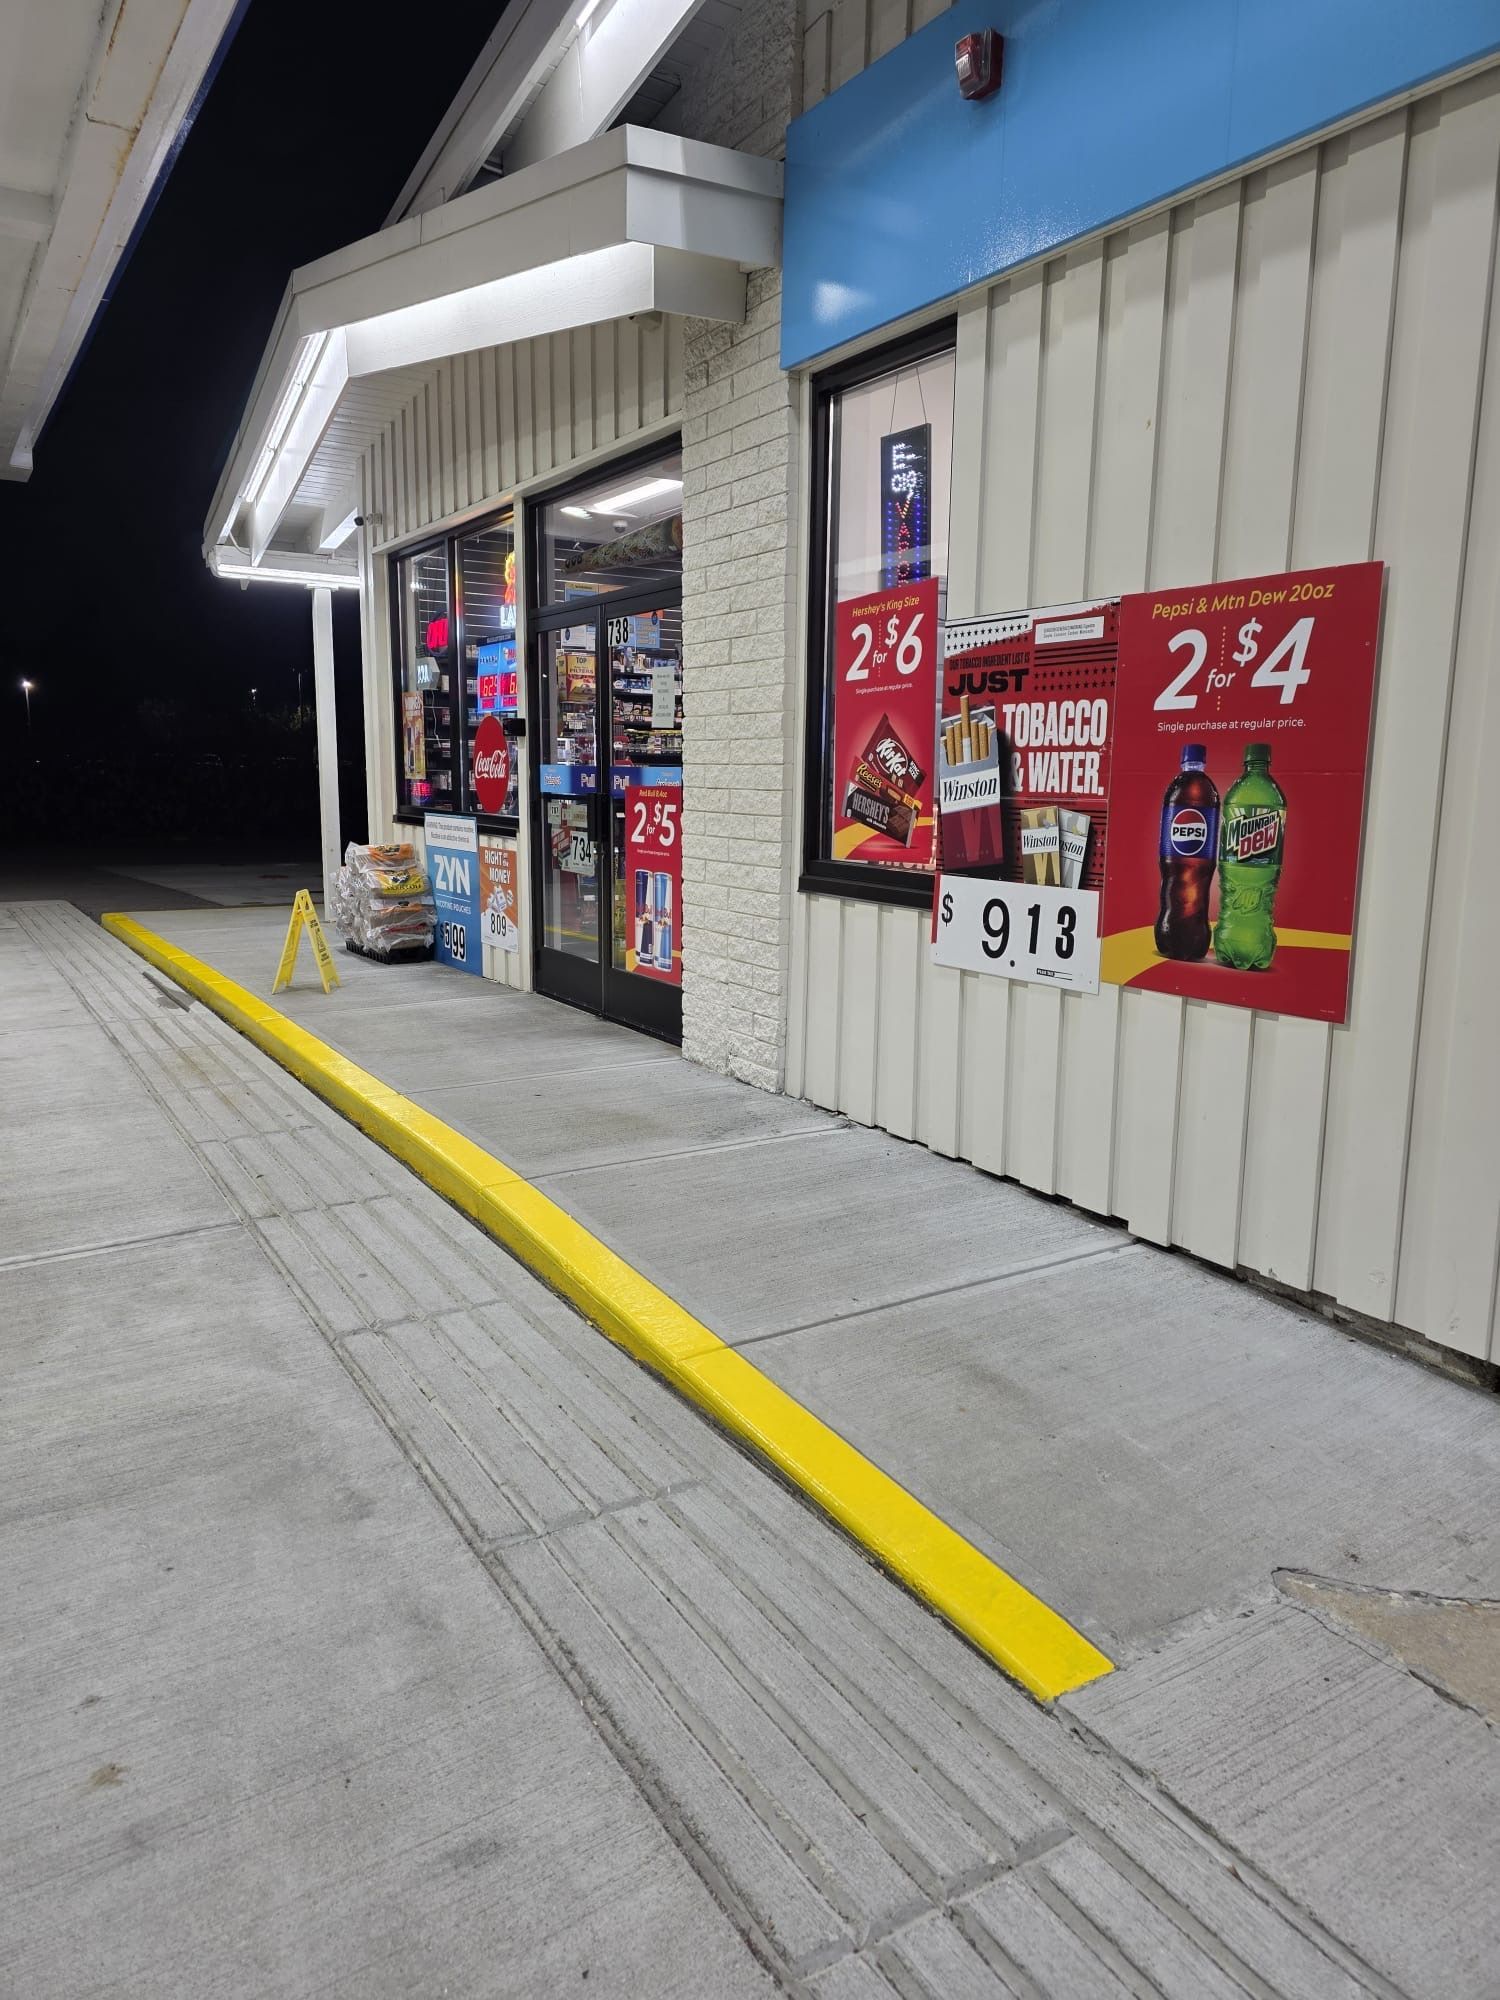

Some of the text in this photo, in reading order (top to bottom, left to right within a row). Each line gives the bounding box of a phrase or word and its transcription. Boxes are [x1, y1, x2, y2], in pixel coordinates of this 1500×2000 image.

[852, 596, 920, 618] Hershey's King Size
[1152, 583, 1335, 620] Pepsi & Mtn Dew 20oz
[608, 618, 628, 646] 738
[846, 623, 873, 682] 2
[872, 650, 888, 668] for
[960, 656, 981, 669] TOBACCO
[982, 653, 1011, 667] INGREDIENT
[1012, 652, 1024, 664] LIST
[1024, 652, 1030, 663] IS
[948, 668, 1029, 696] JUST
[1153, 628, 1208, 711] 2
[1206, 668, 1236, 692] for
[1002, 699, 1108, 747] TOBACCO
[1158, 717, 1306, 734] Single purchase at regular price.
[581, 774, 596, 788] Pull
[614, 776, 630, 790] Pull
[857, 763, 882, 788] Reese's
[1011, 751, 1104, 796] & WATER.
[943, 778, 997, 802] Winston
[852, 792, 890, 824] HERSHEY'S
[631, 802, 647, 843] 2
[646, 824, 655, 835] for
[1172, 827, 1206, 837] PEPSI
[572, 836, 591, 862] 734
[1023, 834, 1057, 848] Winston
[484, 850, 502, 865] RIGHT
[434, 854, 471, 896] ZYN
[490, 867, 511, 884] MONEY
[453, 904, 471, 915] POUCHES
[942, 891, 953, 927] $
[491, 913, 507, 936] 809
